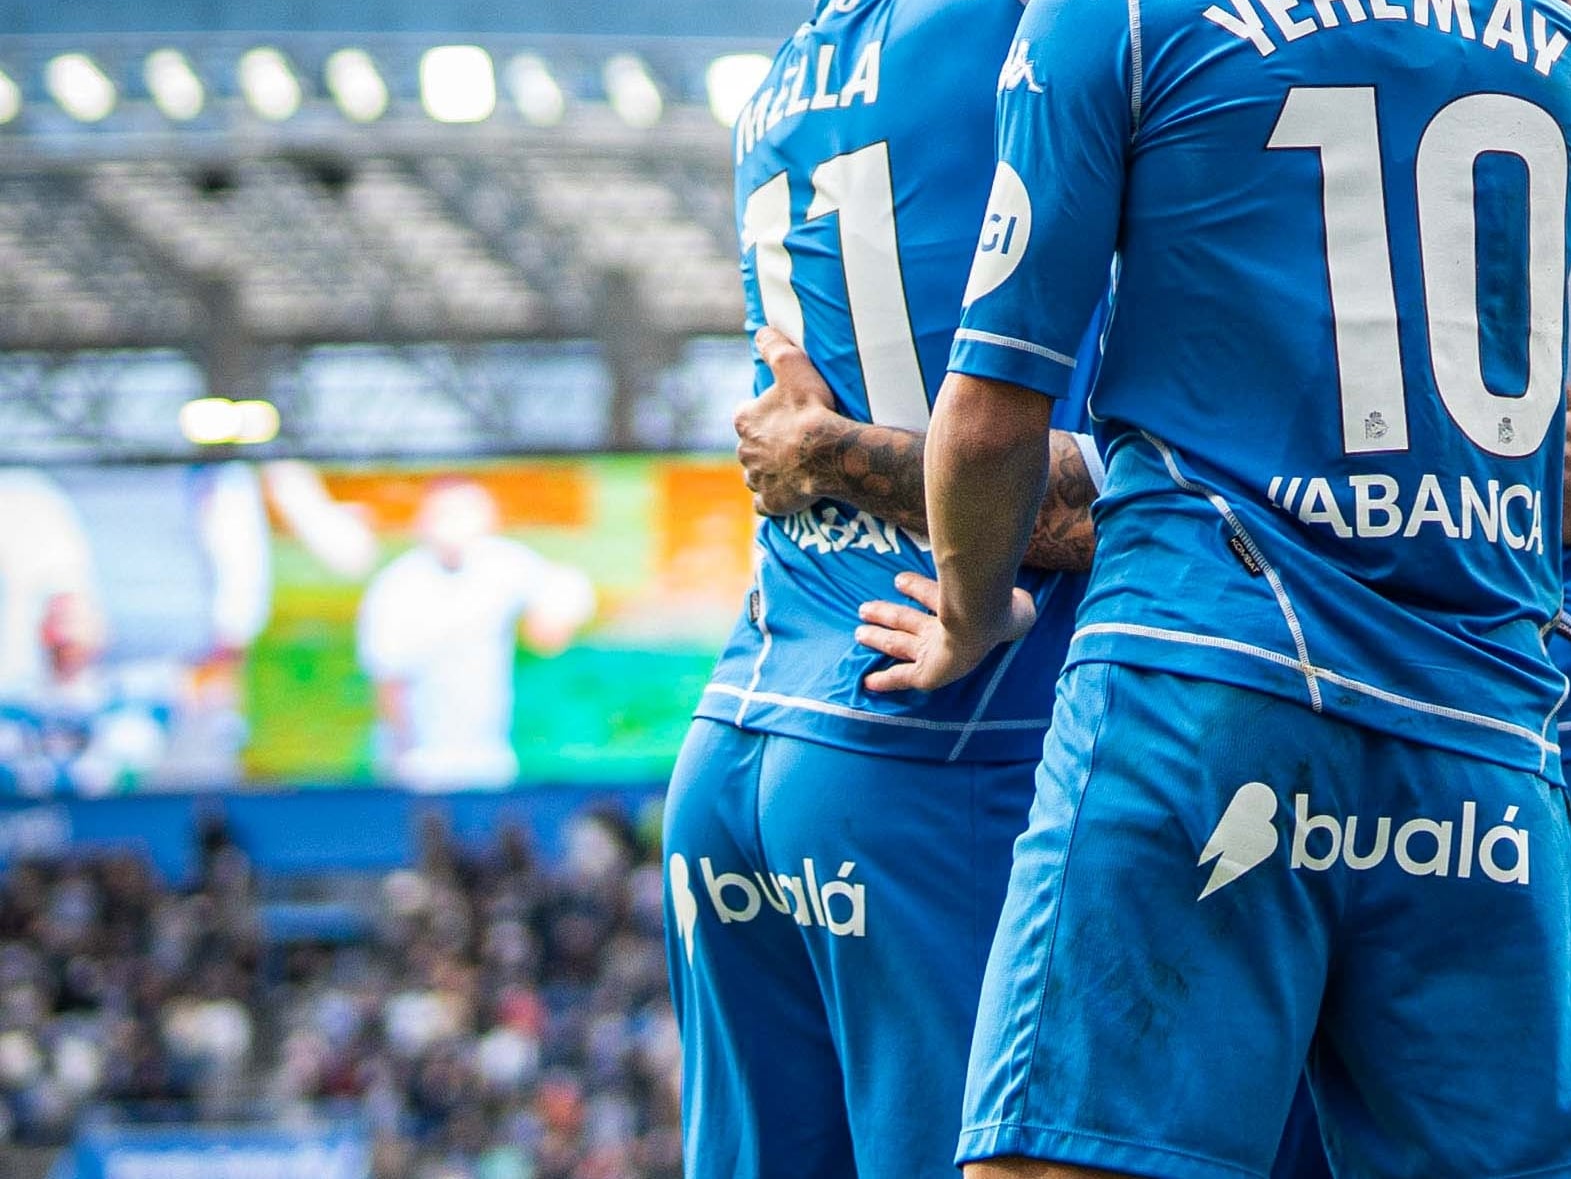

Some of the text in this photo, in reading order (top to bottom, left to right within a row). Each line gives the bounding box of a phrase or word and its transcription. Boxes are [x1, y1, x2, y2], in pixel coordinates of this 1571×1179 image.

[740, 139, 931, 436] 11
[1265, 85, 1568, 457] 10
[1230, 537, 1260, 573] KOMBAT
[1291, 793, 1529, 885] bualá
[699, 857, 865, 937] bualá
